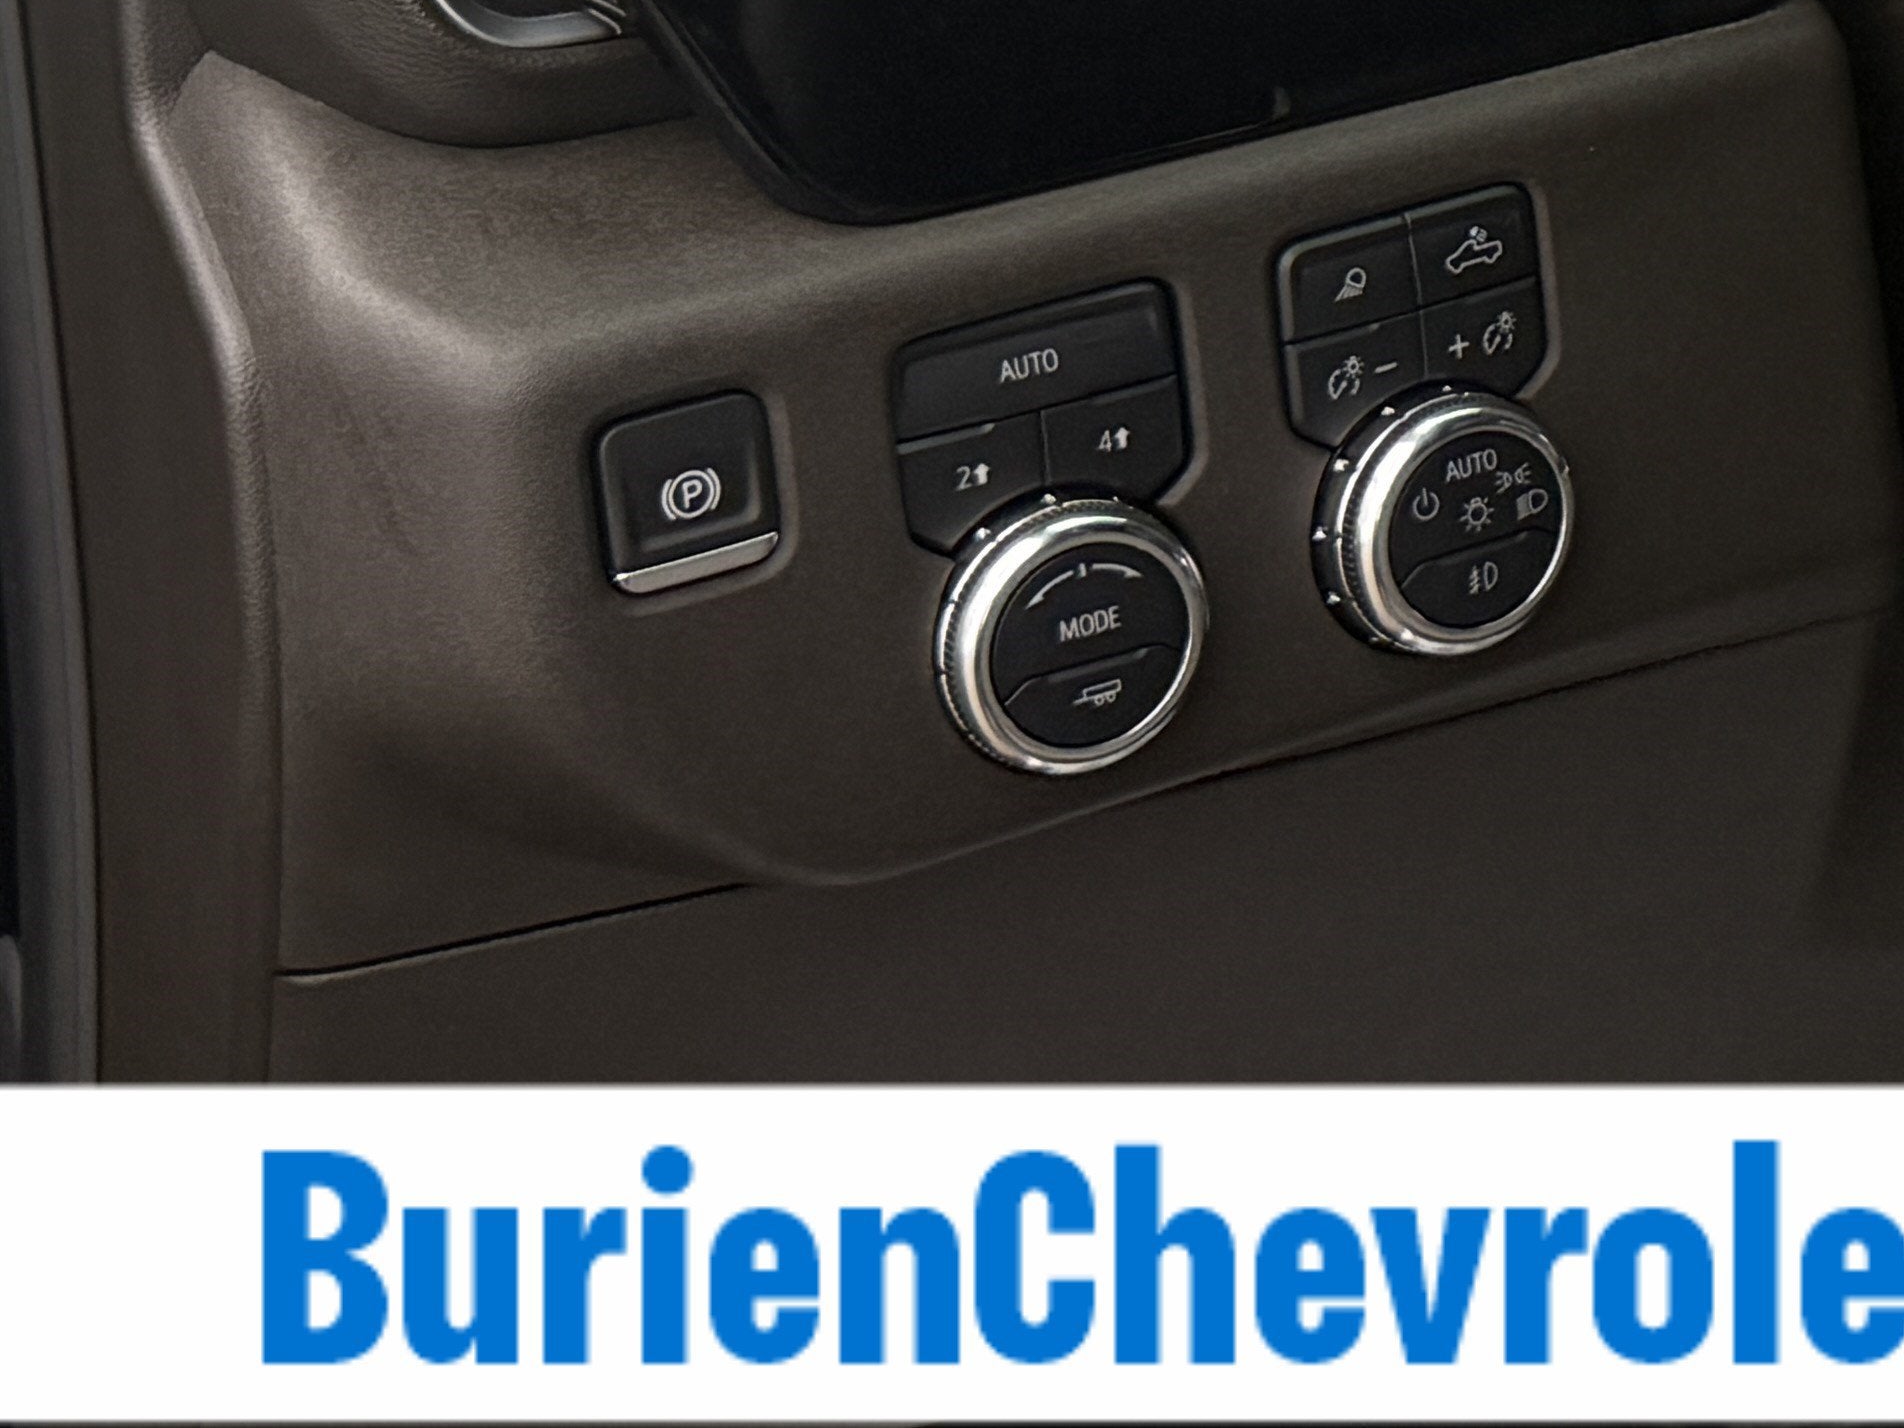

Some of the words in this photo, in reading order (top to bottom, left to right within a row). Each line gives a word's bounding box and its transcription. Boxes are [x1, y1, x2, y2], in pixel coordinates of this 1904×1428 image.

[999, 348, 1060, 385] AUTO
[1444, 448, 1497, 482] AUTO
[1057, 604, 1122, 642] MODE
